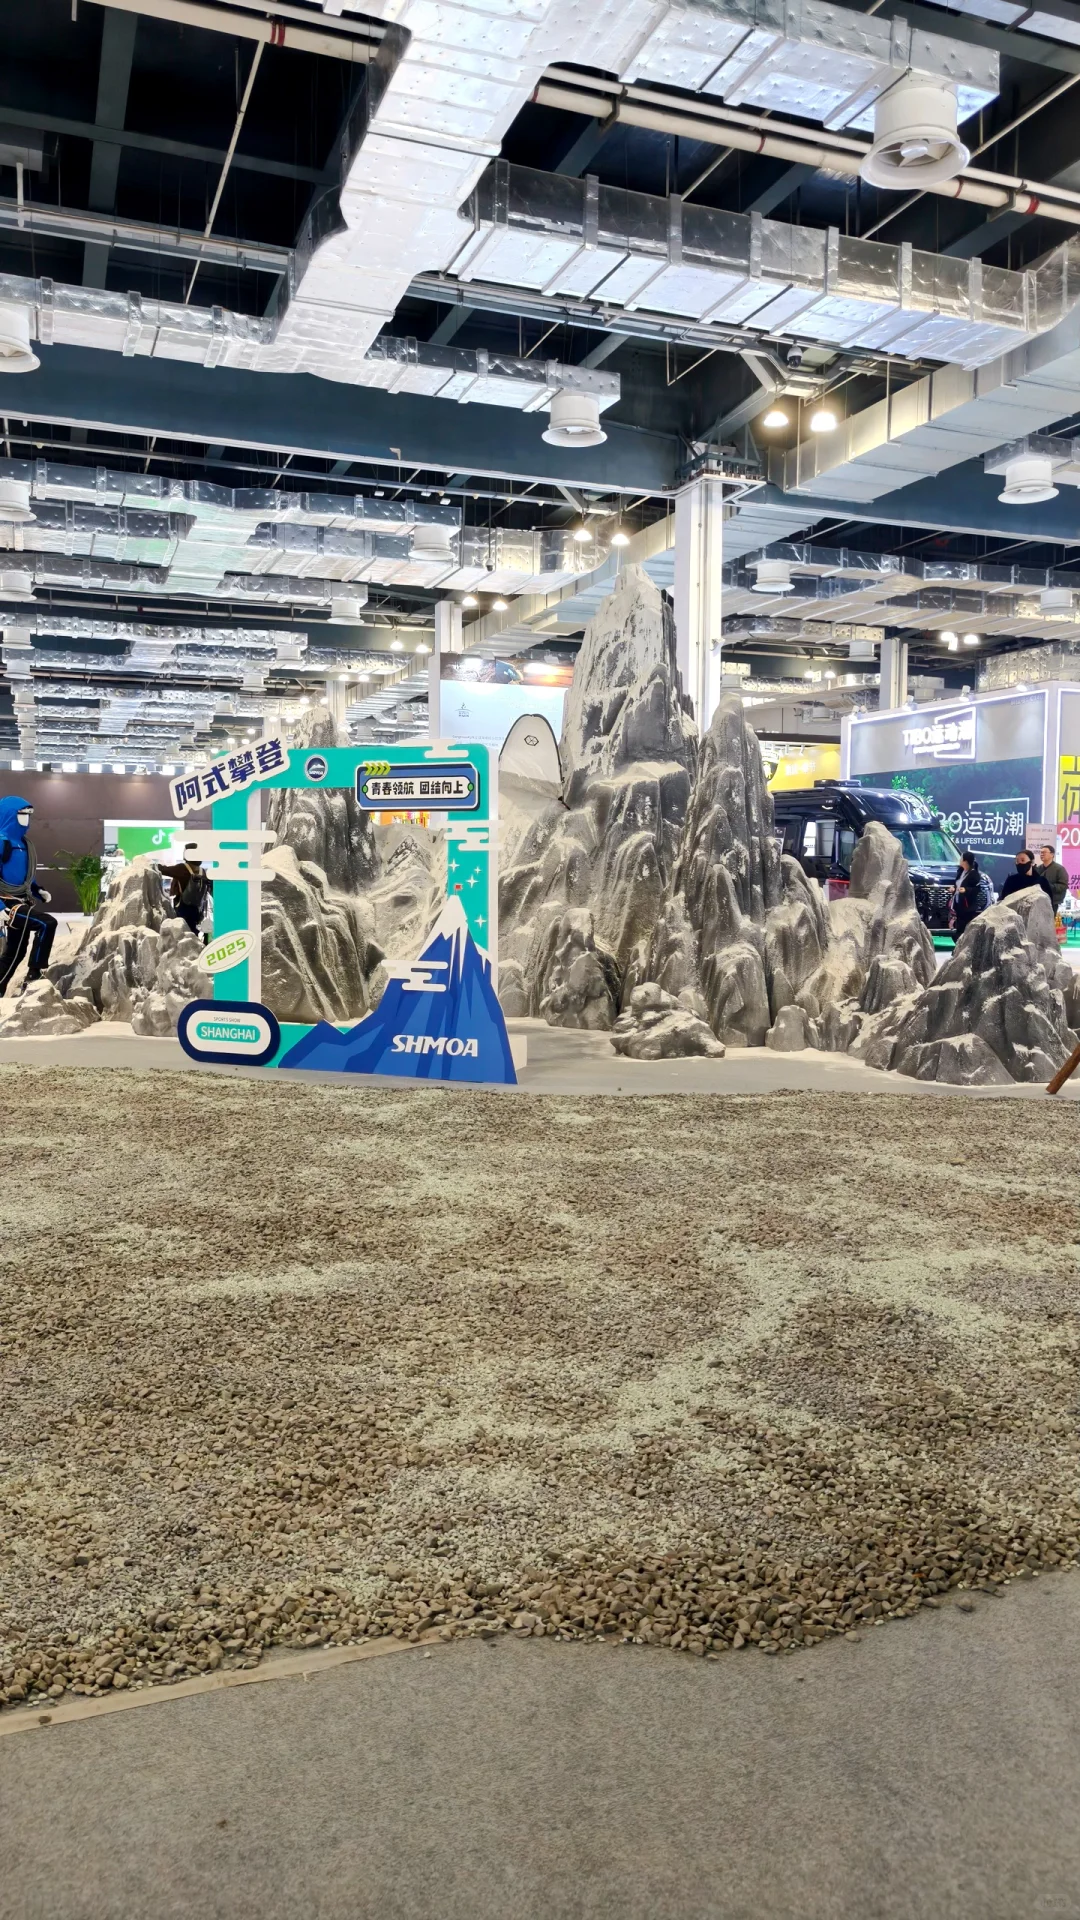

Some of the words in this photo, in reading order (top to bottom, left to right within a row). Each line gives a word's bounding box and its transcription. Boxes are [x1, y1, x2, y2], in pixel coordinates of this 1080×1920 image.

[174, 738, 285, 811] 阿式攀登
[371, 781, 415, 796] 青春领航
[419, 780, 464, 795] 团结向上
[961, 837, 992, 845] LIFESTYLE
[206, 937, 247, 966] 2025
[200, 1025, 256, 1041] SHANGHAI
[390, 1034, 479, 1058] SHMOA
